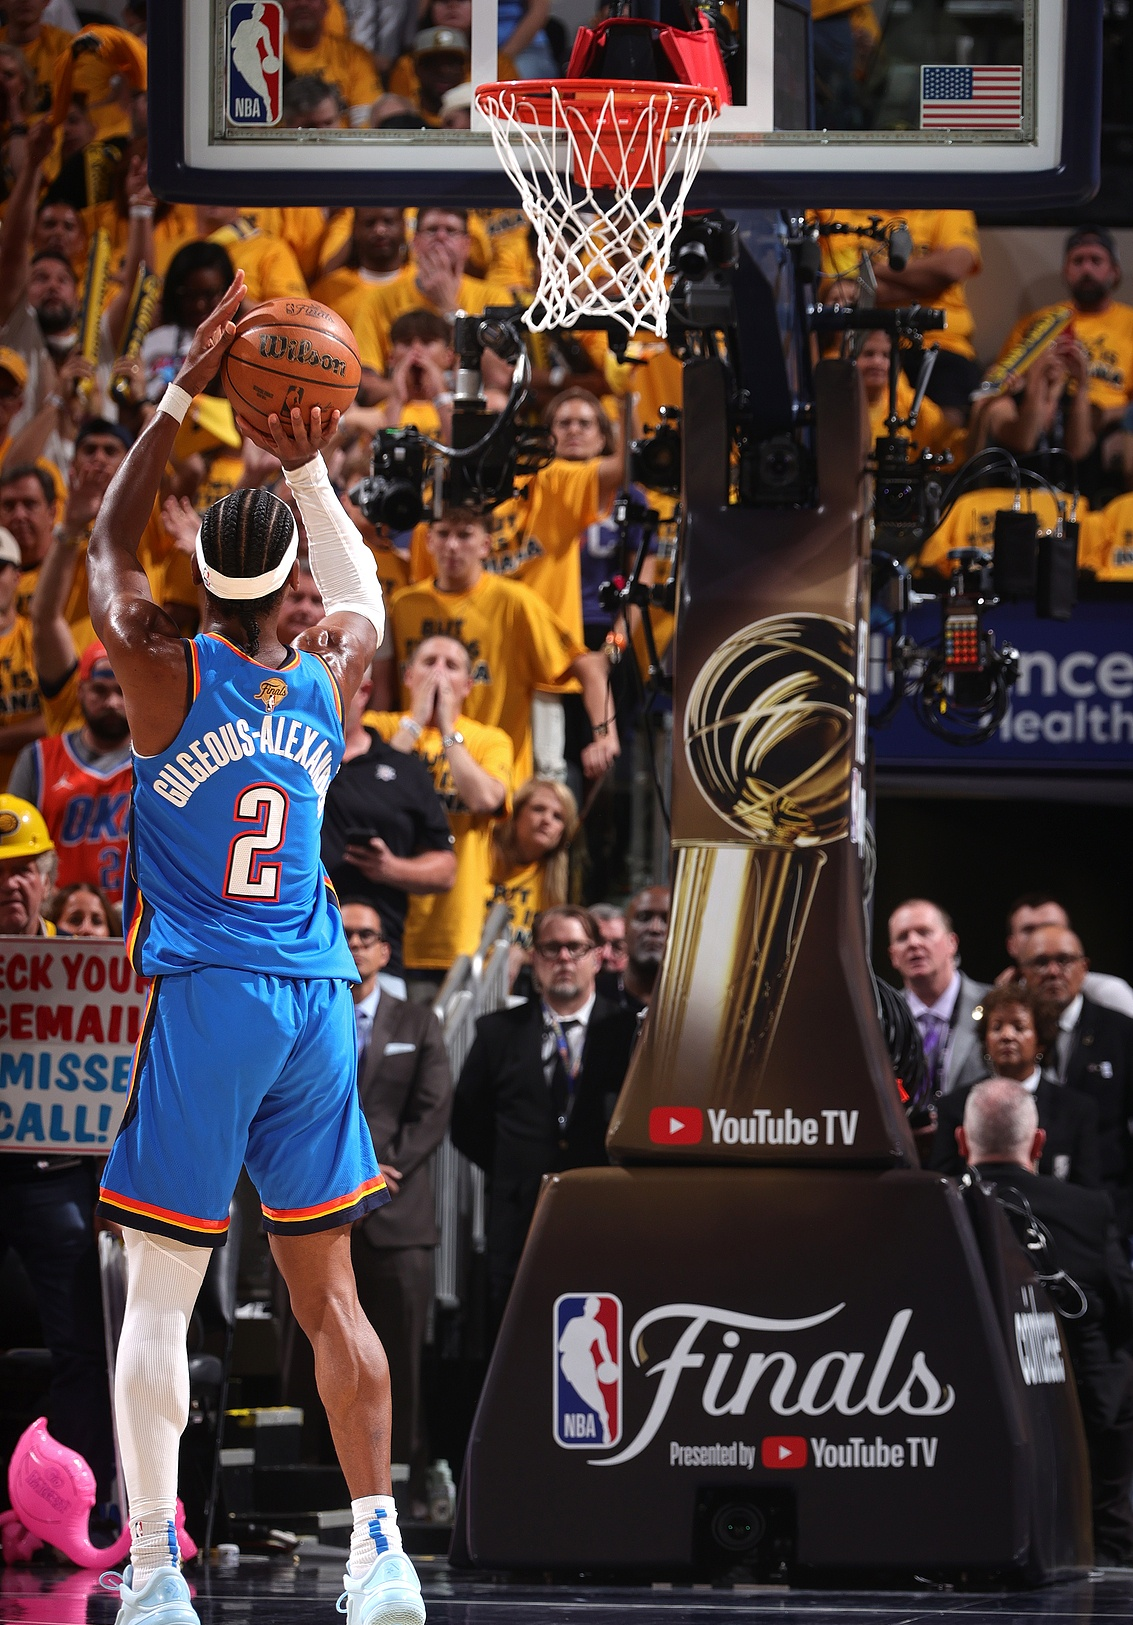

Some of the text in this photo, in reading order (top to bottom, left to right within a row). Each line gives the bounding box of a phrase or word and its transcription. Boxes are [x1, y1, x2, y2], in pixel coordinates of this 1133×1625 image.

[235, 97, 261, 117] NBA
[259, 333, 347, 377] Wilson
[254, 682, 287, 698] Finals
[60, 792, 130, 846] OK
[222, 781, 291, 902] 2
[707, 1108, 859, 1145] YouTube TV
[563, 1413, 597, 1439] NBA
[586, 1302, 956, 1466] Finals
[670, 1437, 939, 1470] Presented by YouTube TV
